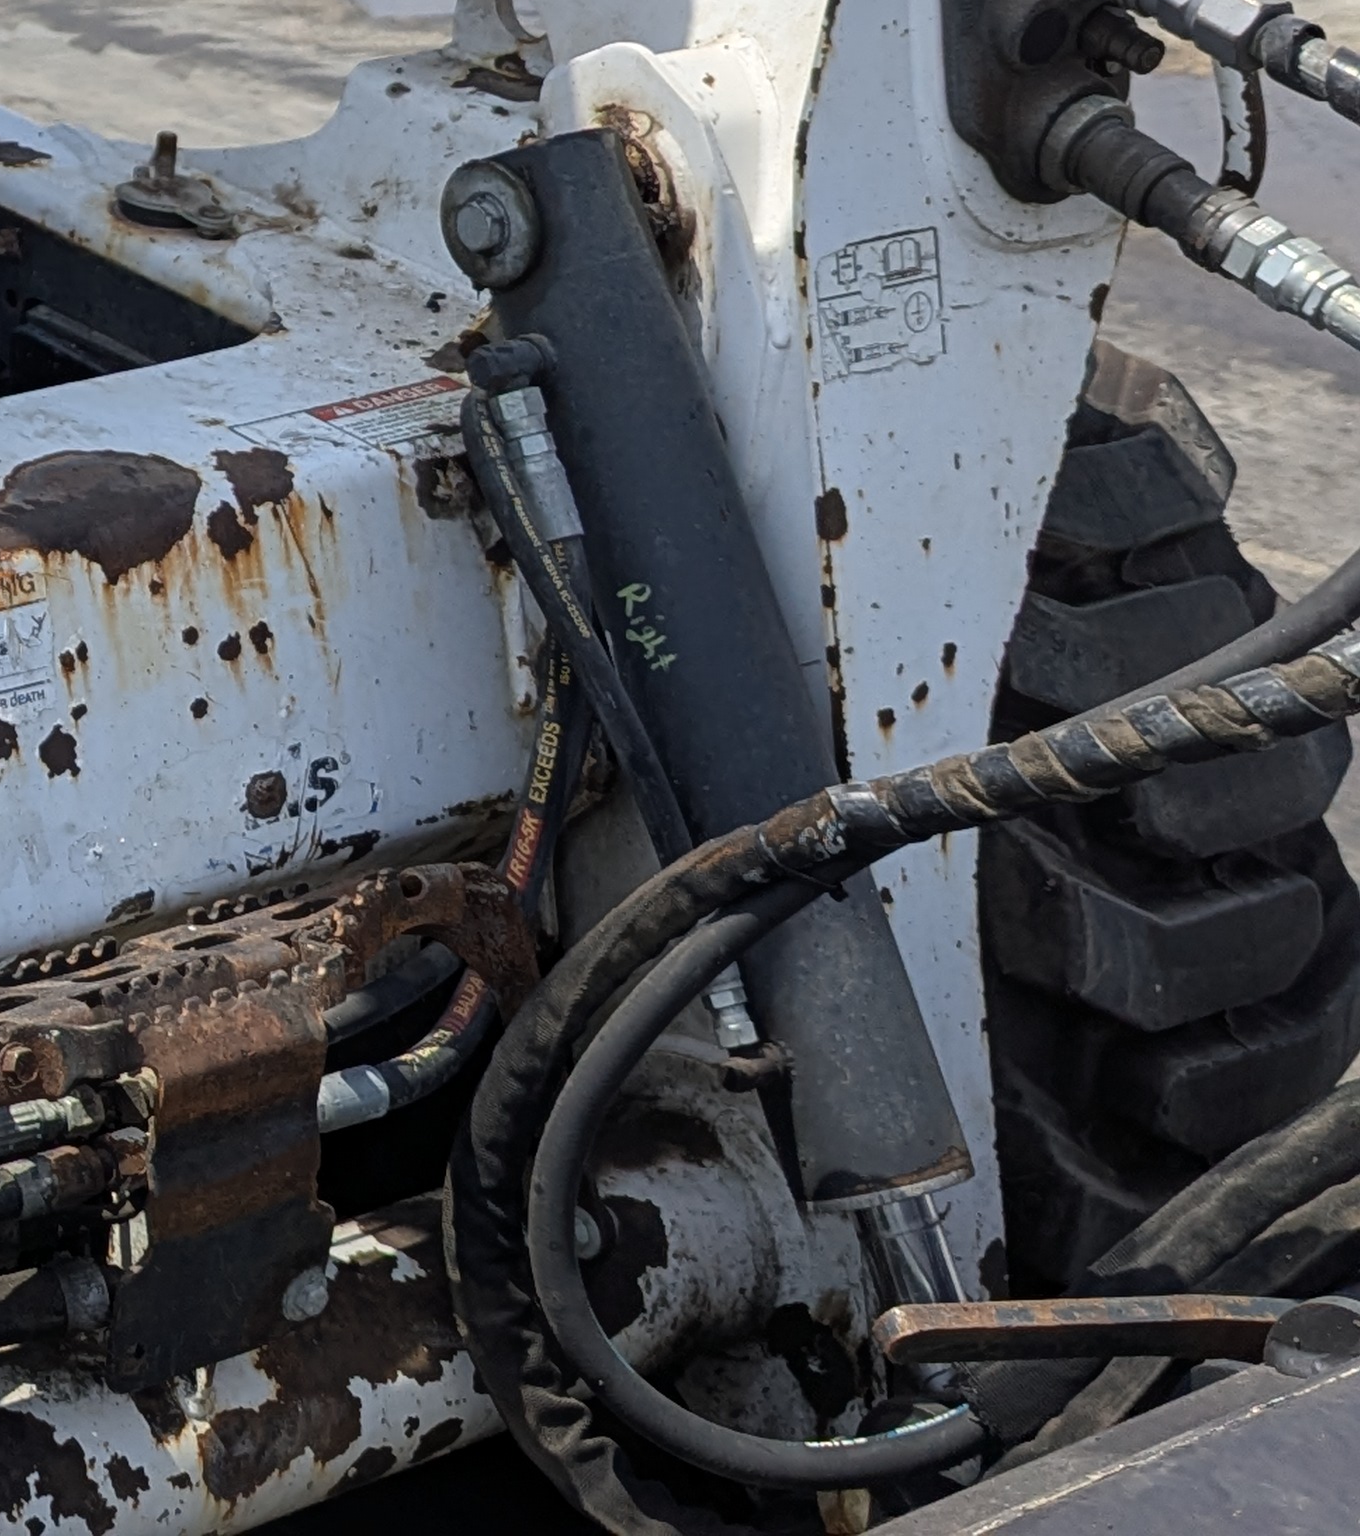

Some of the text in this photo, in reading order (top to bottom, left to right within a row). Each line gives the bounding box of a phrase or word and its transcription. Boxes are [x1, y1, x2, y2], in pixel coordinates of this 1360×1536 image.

[352, 381, 446, 411] DANGER
[616, 582, 678, 671] Right
[528, 720, 561, 805] EXCEEDS
